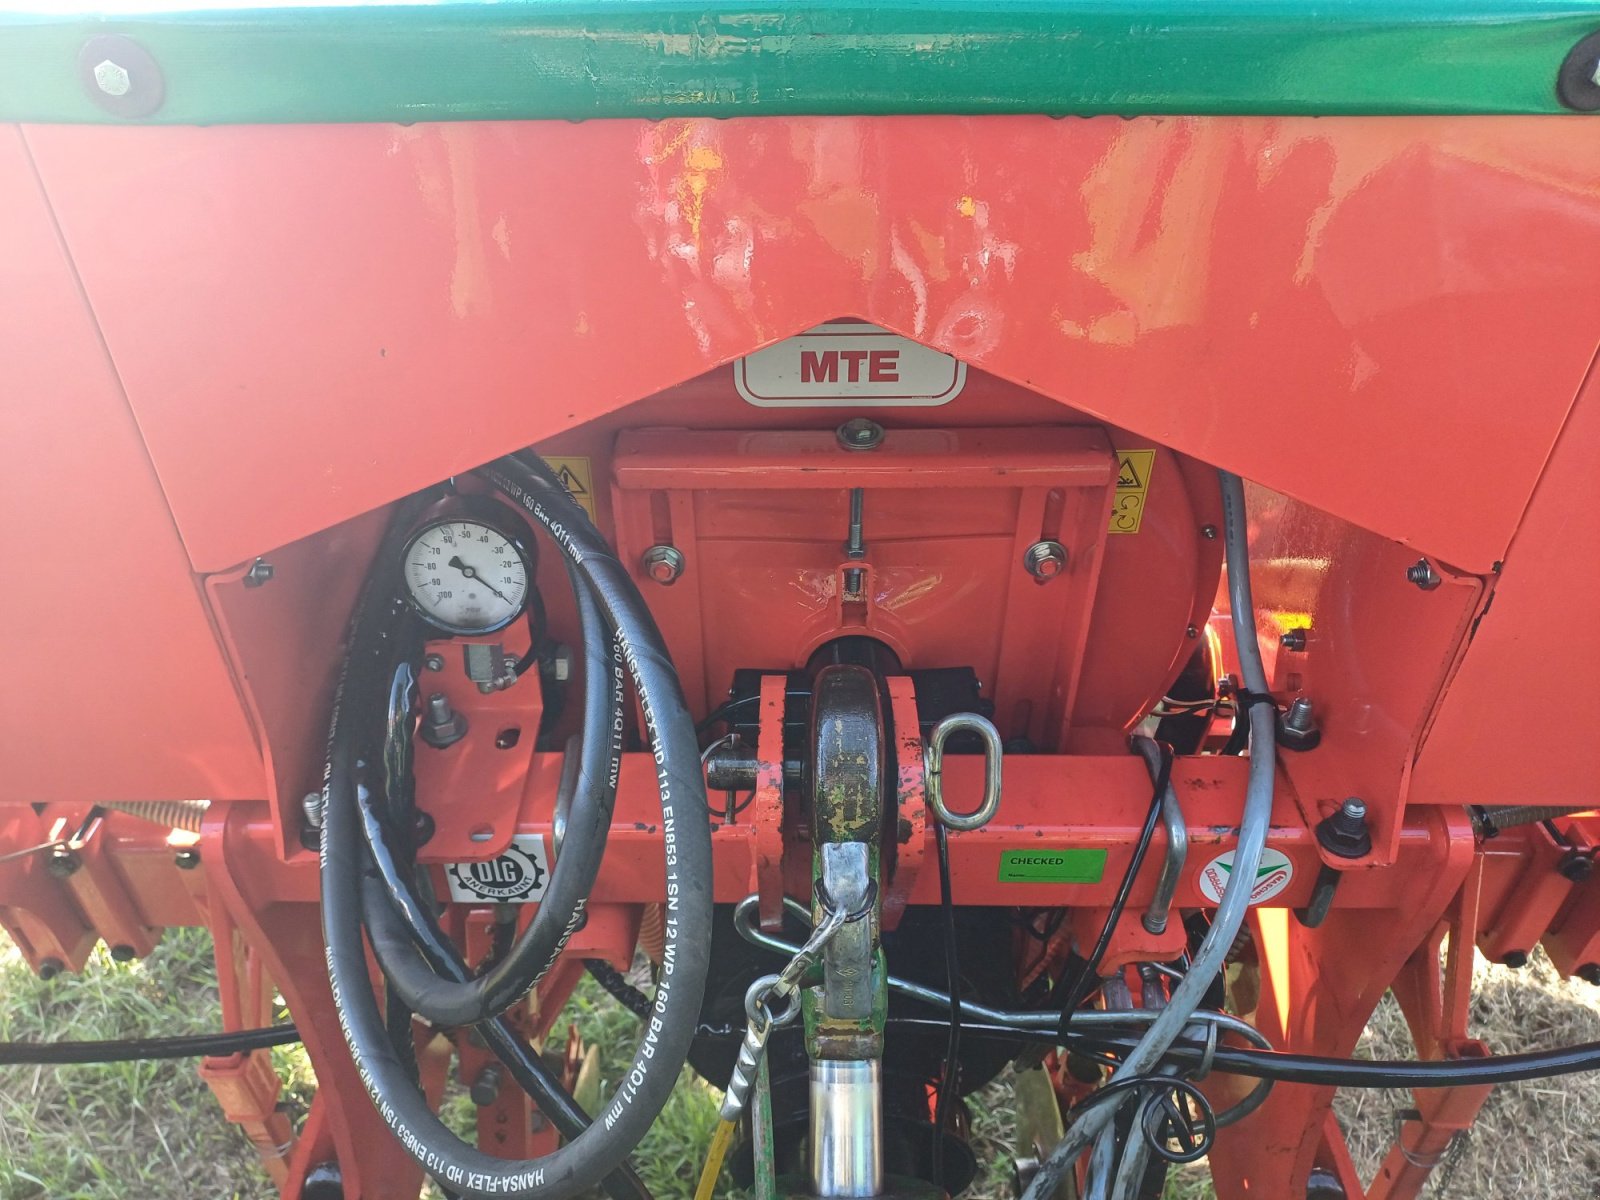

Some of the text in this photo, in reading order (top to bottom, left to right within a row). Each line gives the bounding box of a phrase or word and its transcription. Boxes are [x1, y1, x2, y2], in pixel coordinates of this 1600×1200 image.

[800, 350, 900, 383] MTE
[522, 493, 535, 510] 160
[549, 520, 571, 547] 4Q11
[614, 666, 624, 703] BAR
[612, 707, 624, 751] 4Q11
[652, 738, 665, 766] HD
[658, 769, 671, 801] 113
[662, 806, 677, 866] EN853
[1010, 857, 1064, 865] CHECKED
[464, 875, 533, 896] ANERKANNT
[667, 873, 679, 911] 1SN
[666, 917, 678, 939] 12
[663, 944, 677, 975] WP
[654, 981, 671, 1014] 160
[338, 1009, 353, 1042] BAR
[642, 1016, 664, 1060] BAR
[349, 1041, 362, 1066] 160
[359, 1068, 375, 1092] WP
[622, 1059, 648, 1105] 4Q11
[370, 1088, 382, 1104] 12
[380, 1103, 398, 1129] 1SN
[397, 1124, 427, 1162] EN853
[427, 1154, 445, 1175] 113
[446, 1165, 464, 1185] HD
[466, 1167, 545, 1193] HANSA-FLEX
